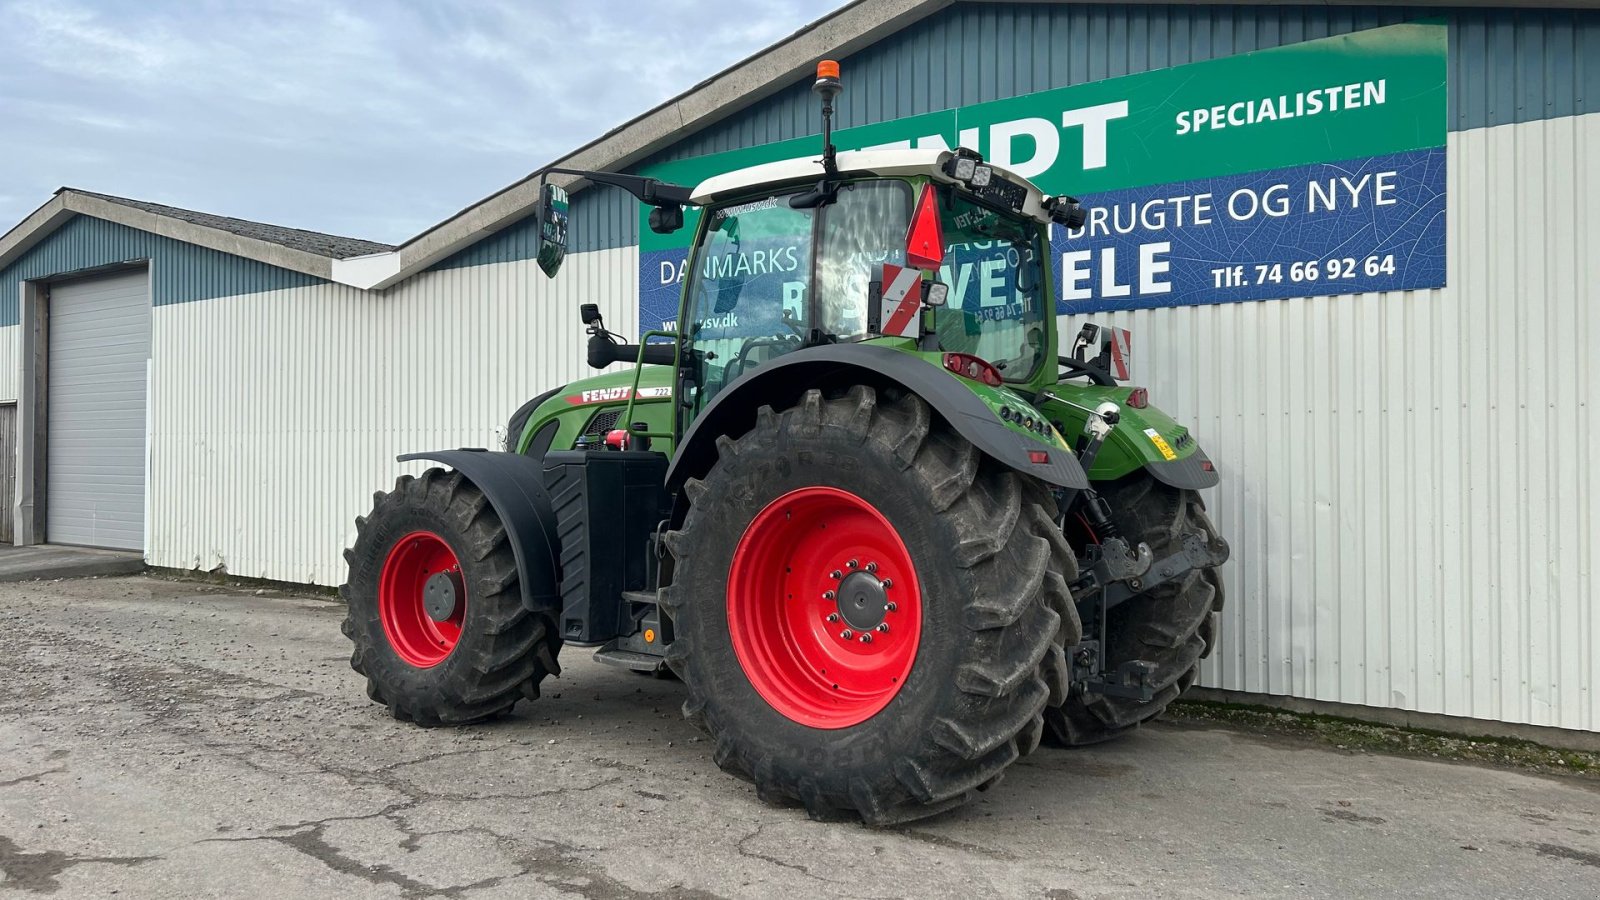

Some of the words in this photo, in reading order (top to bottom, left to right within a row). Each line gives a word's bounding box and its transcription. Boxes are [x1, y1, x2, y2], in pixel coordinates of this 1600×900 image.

[1175, 79, 1386, 135] SPECIALISTEN
[1227, 184, 1290, 222] OG
[1308, 171, 1397, 214] NYE
[1211, 265, 1249, 289] Tlf.
[1255, 263, 1283, 286] 74
[1290, 260, 1319, 282] 66
[1326, 258, 1356, 280] 92
[1364, 254, 1396, 277] 64
[581, 385, 633, 403] FENDT
[655, 388, 669, 396] 722
